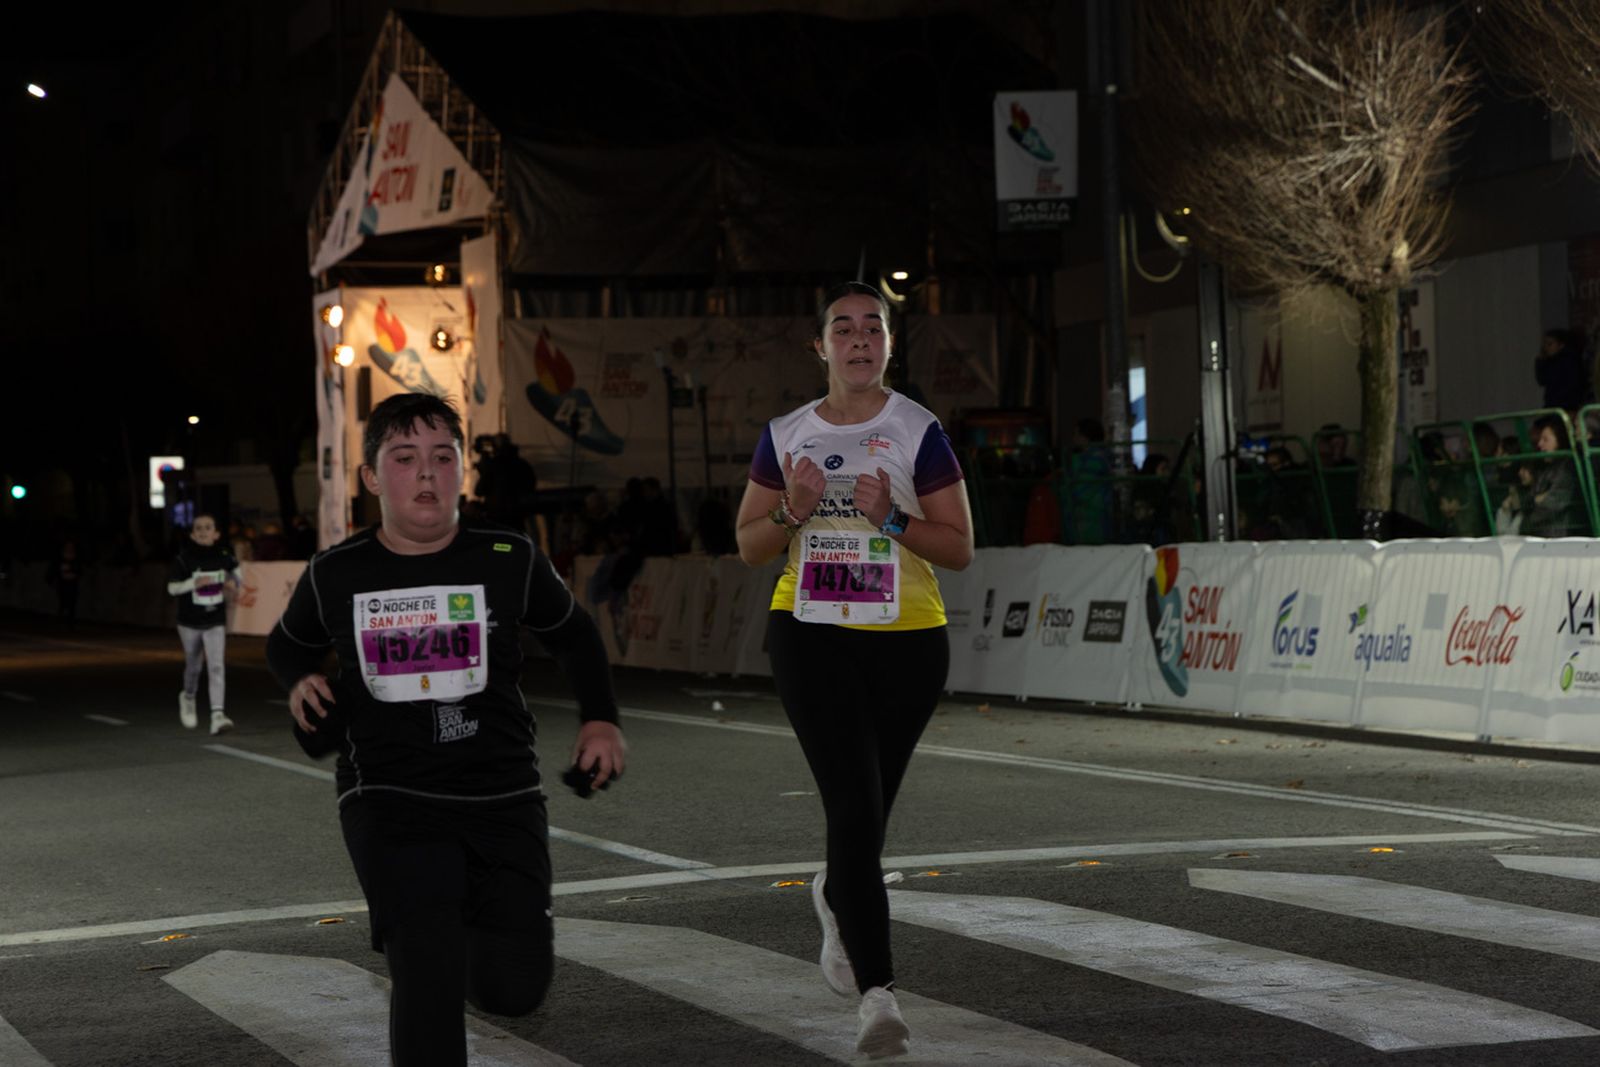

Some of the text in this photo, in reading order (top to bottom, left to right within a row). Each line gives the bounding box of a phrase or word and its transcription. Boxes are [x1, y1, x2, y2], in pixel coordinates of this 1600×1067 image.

[553, 397, 593, 437] 43
[809, 551, 827, 562] SAN
[820, 540, 847, 551] NOCHE
[848, 541, 860, 551] DE
[369, 615, 394, 629] SAN
[383, 600, 420, 613] NOCHE
[422, 599, 437, 611] DE
[1184, 585, 1224, 625] SAN
[1557, 589, 1600, 636] XA
[372, 625, 470, 664] 15246
[1154, 602, 1180, 663] 43
[1176, 620, 1243, 672] ANTÓN
[1354, 623, 1412, 672] aqualia
